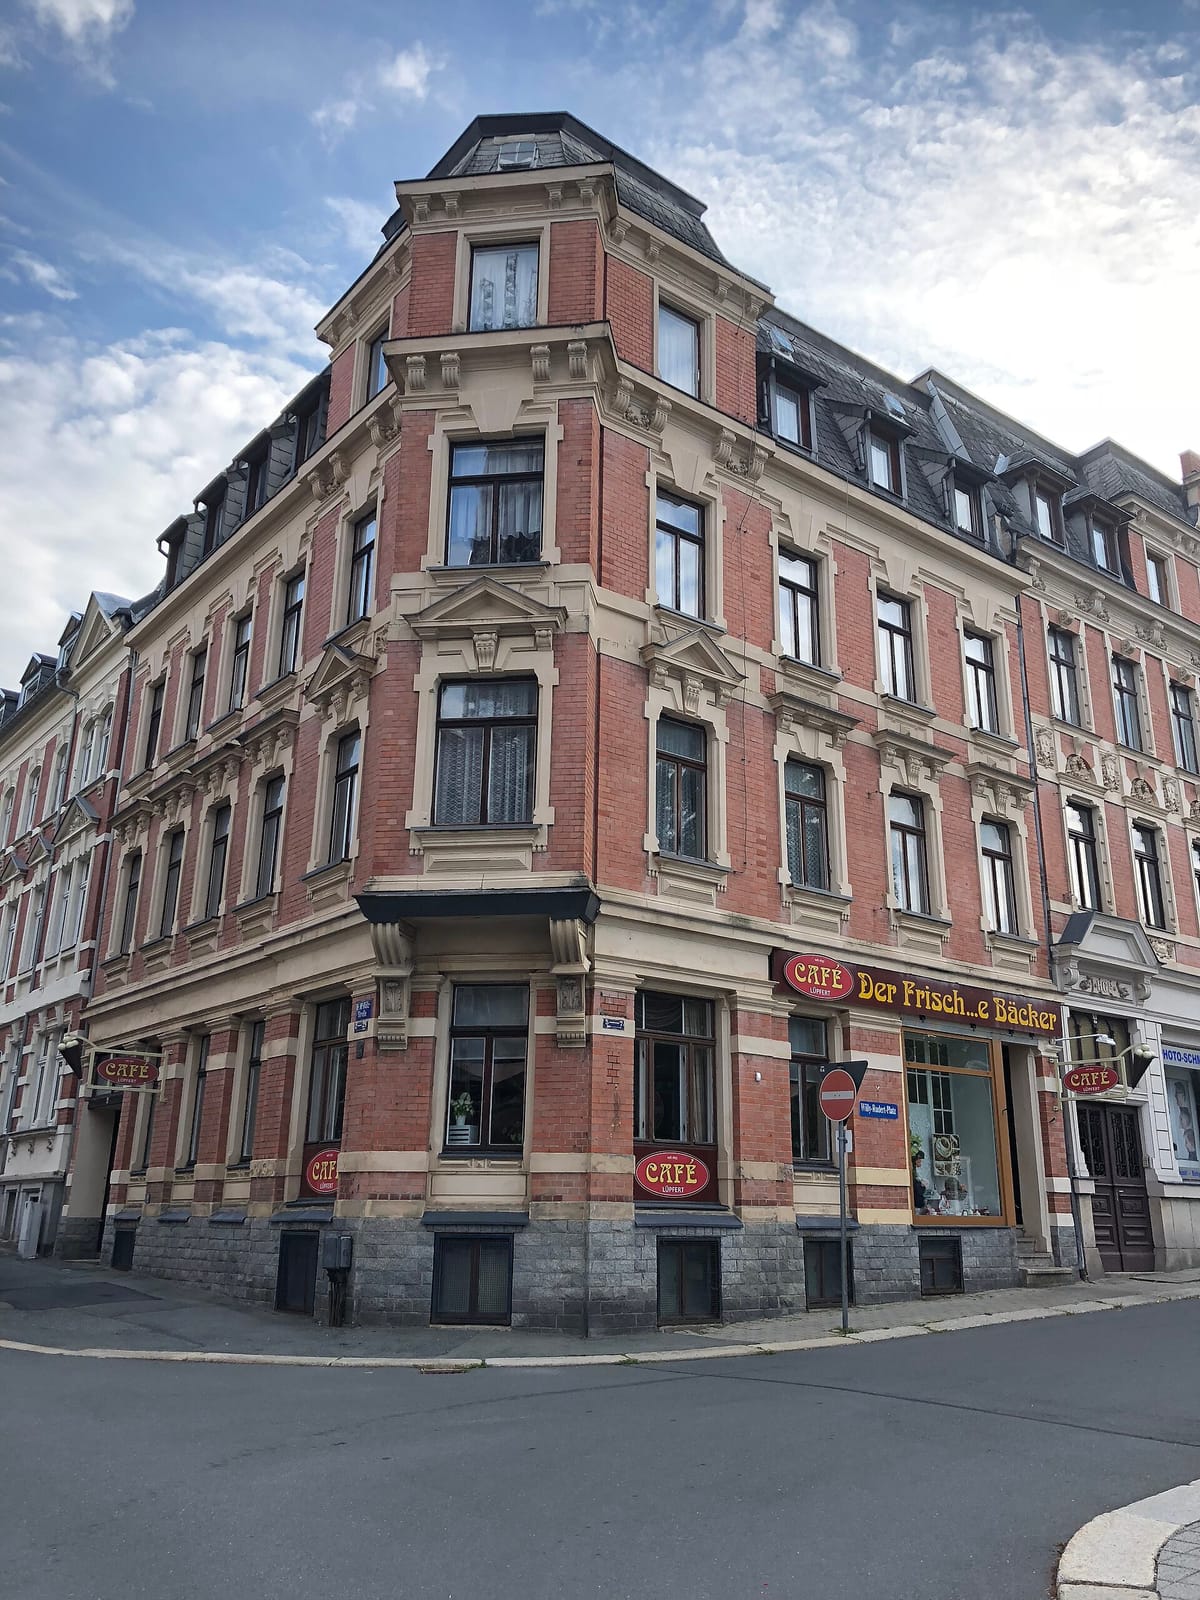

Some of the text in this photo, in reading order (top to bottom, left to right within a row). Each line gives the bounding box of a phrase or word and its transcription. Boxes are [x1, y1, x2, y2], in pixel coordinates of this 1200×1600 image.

[795, 962, 843, 989] CAFÉ
[809, 986, 831, 995] LÜPFERT
[858, 971, 1057, 1031] Der Frisch...e Bäcker
[105, 1063, 149, 1078] CAFÉ
[1070, 1068, 1110, 1086] CAFÉ
[312, 1160, 339, 1180] CAF
[645, 1158, 698, 1184] CAFÉ
[662, 1185, 684, 1193] LÜPFERT
